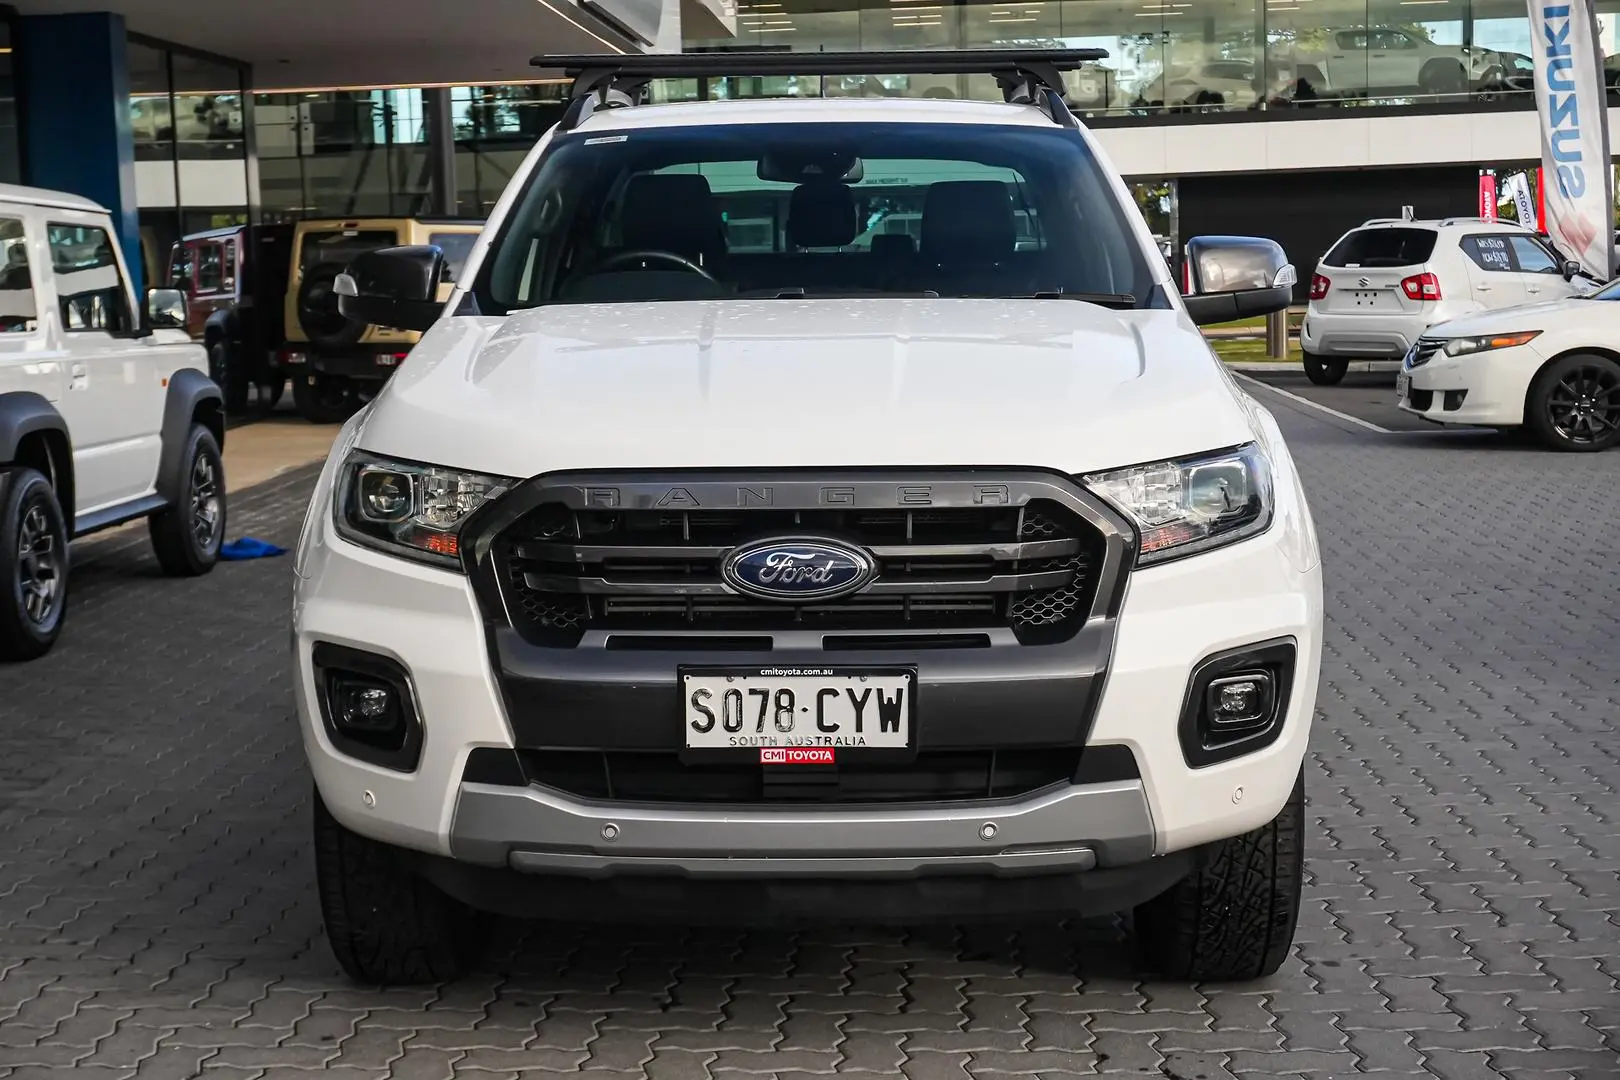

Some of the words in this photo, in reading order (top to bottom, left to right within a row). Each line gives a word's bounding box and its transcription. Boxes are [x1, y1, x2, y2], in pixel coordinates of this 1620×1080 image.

[584, 485, 1009, 506] RANGER
[758, 552, 834, 583] Ford
[760, 667, 834, 677] cmitoyota.com.au
[729, 736, 778, 746] SOUTH
[786, 736, 866, 746] AUSTRALIA
[763, 751, 785, 760] CMI
[787, 751, 832, 760] TOYOTA
